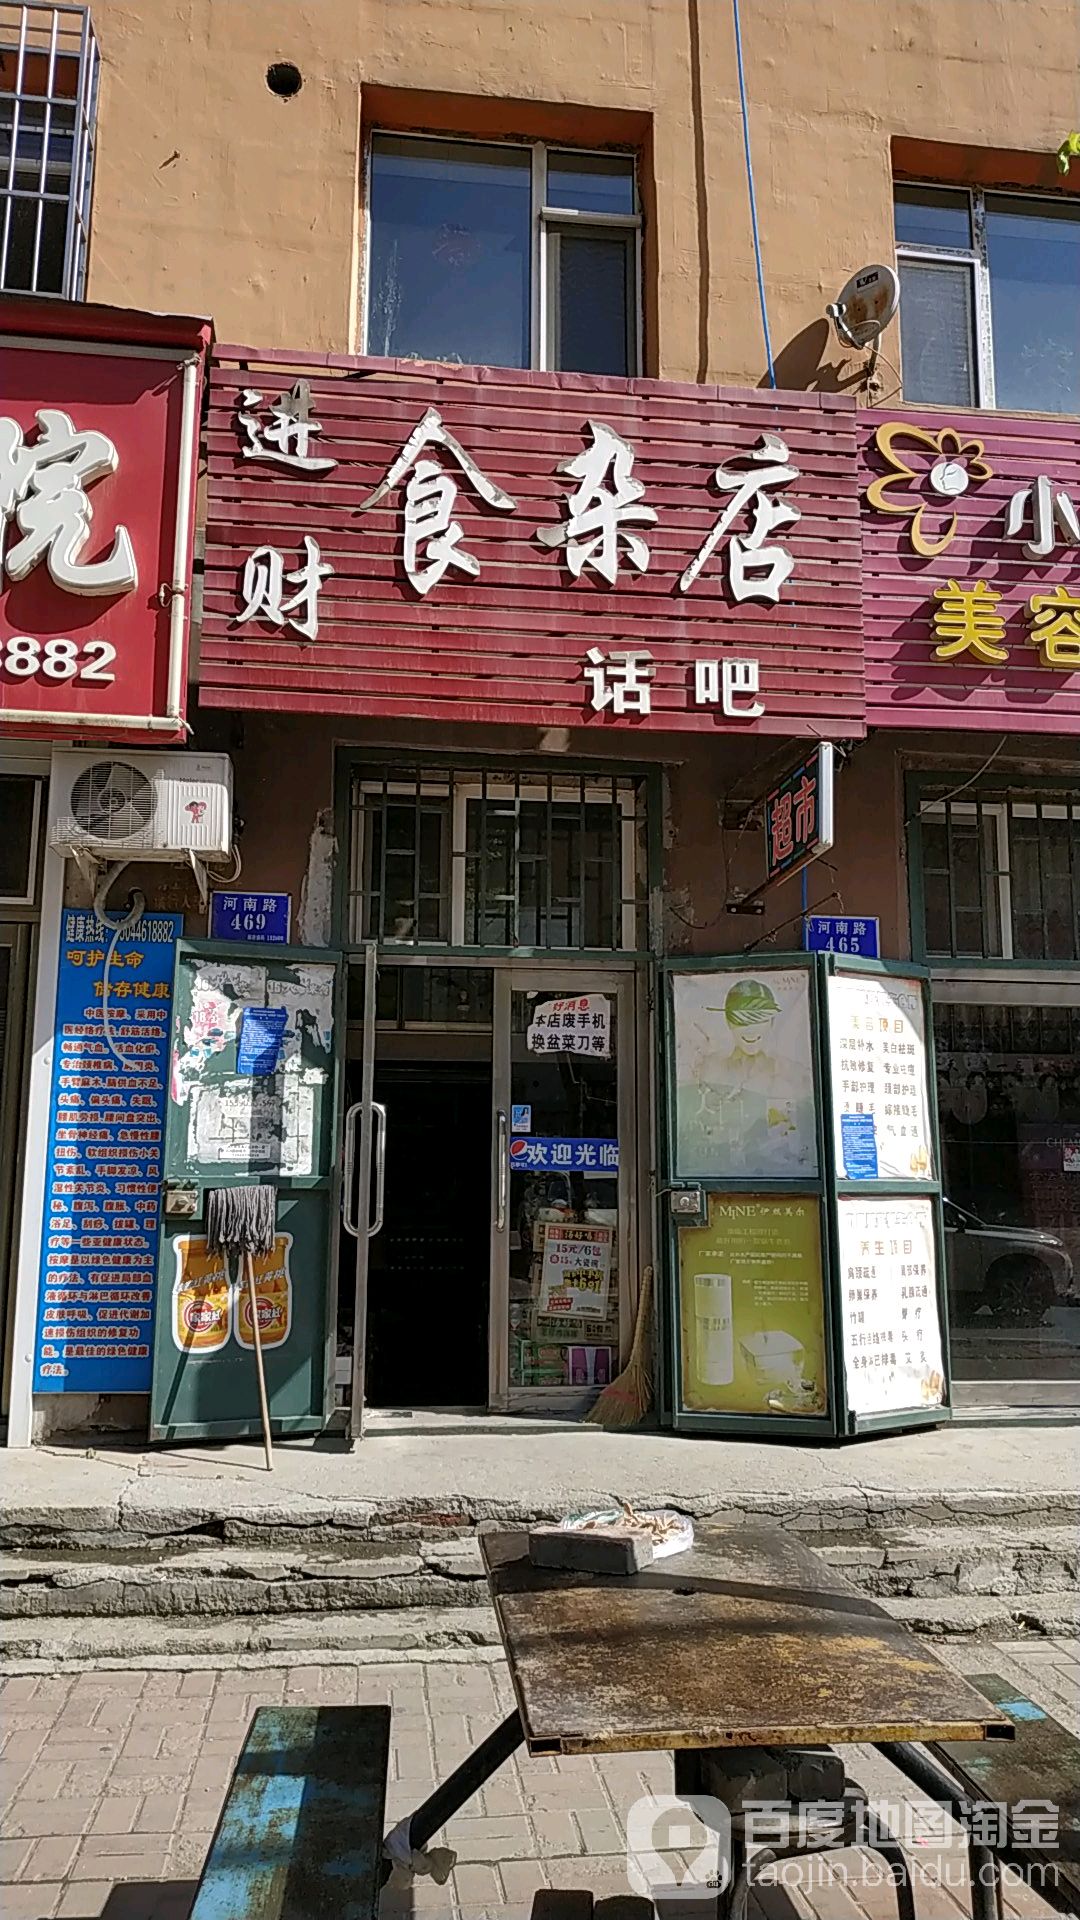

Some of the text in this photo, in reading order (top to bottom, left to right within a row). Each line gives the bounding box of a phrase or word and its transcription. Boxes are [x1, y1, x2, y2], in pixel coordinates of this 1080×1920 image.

[361, 406, 803, 603] 食杂店
[1004, 474, 1080, 559] 小
[932, 577, 1080, 668] 美容
[583, 647, 766, 719] 话吧
[771, 776, 817, 866] 超市
[223, 896, 278, 913] 河南路
[231, 914, 266, 930] 469
[818, 921, 867, 935] 河南路
[825, 937, 860, 953] 465
[66, 950, 145, 968] 呵护生命
[553, 999, 590, 1012] 好消息
[535, 1013, 605, 1029] 本店废手机
[532, 1034, 605, 1052] 换盆菜刀等
[527, 1143, 619, 1166] 欢迎光临
[47, 1253, 154, 1266] 按摩是以绿色健康为主
